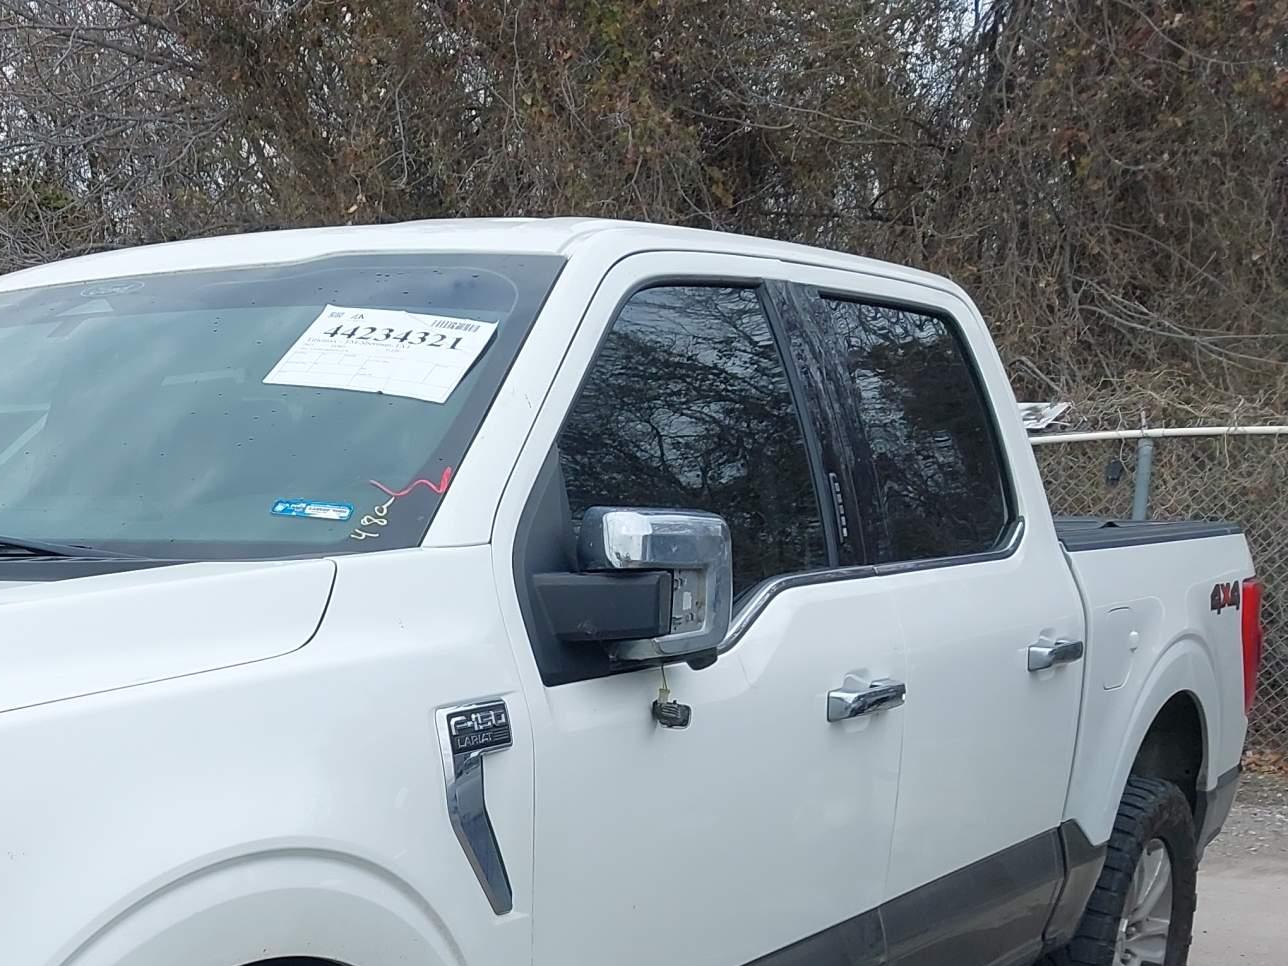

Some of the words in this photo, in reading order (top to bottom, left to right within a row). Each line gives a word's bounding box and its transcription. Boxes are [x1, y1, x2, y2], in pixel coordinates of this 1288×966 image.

[323, 324, 464, 350] 44234321
[450, 710, 506, 736] F-150
[456, 732, 493, 749] LARIAT
